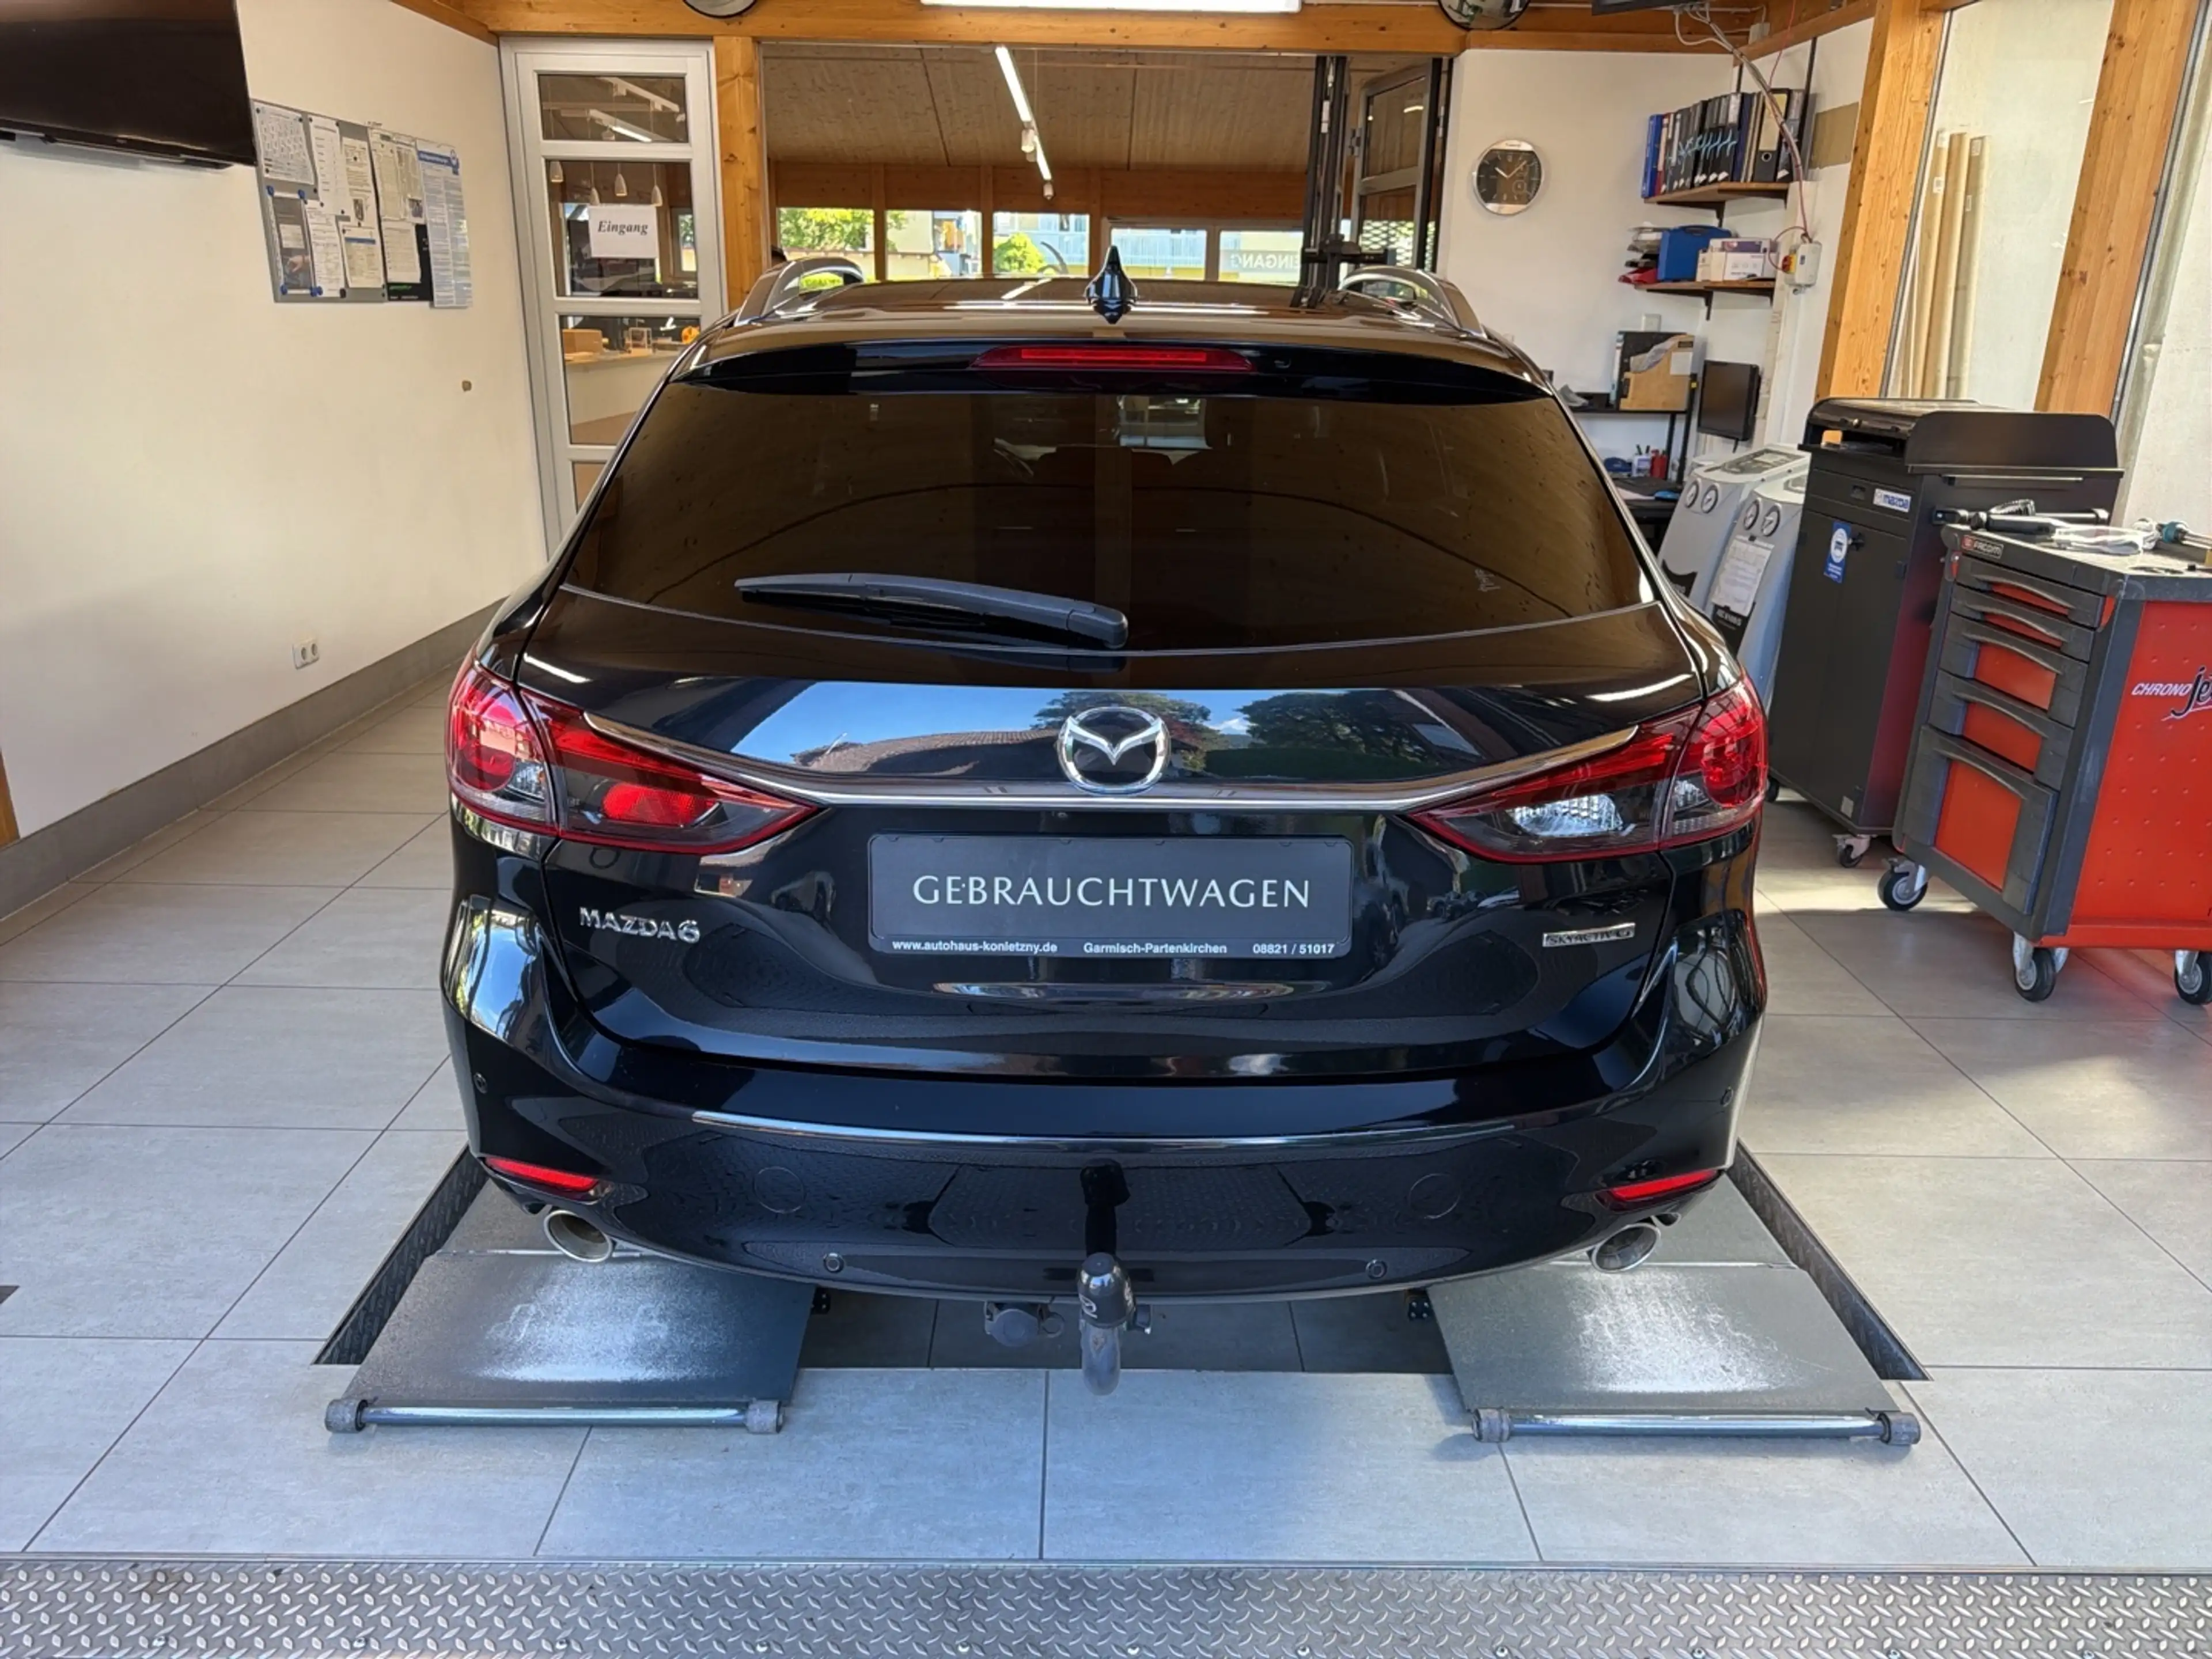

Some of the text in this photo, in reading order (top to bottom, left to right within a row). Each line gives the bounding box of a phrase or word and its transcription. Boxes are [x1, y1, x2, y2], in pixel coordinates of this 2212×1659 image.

[598, 220, 648, 236] Eingang
[2131, 665, 2212, 719] CHRONO je
[912, 874, 1309, 908] GEBRAUCHTWAGEN
[892, 940, 1335, 955] www.autohaus-konietzny.de Garmisch-Partenkirchen 08821 / 51017
